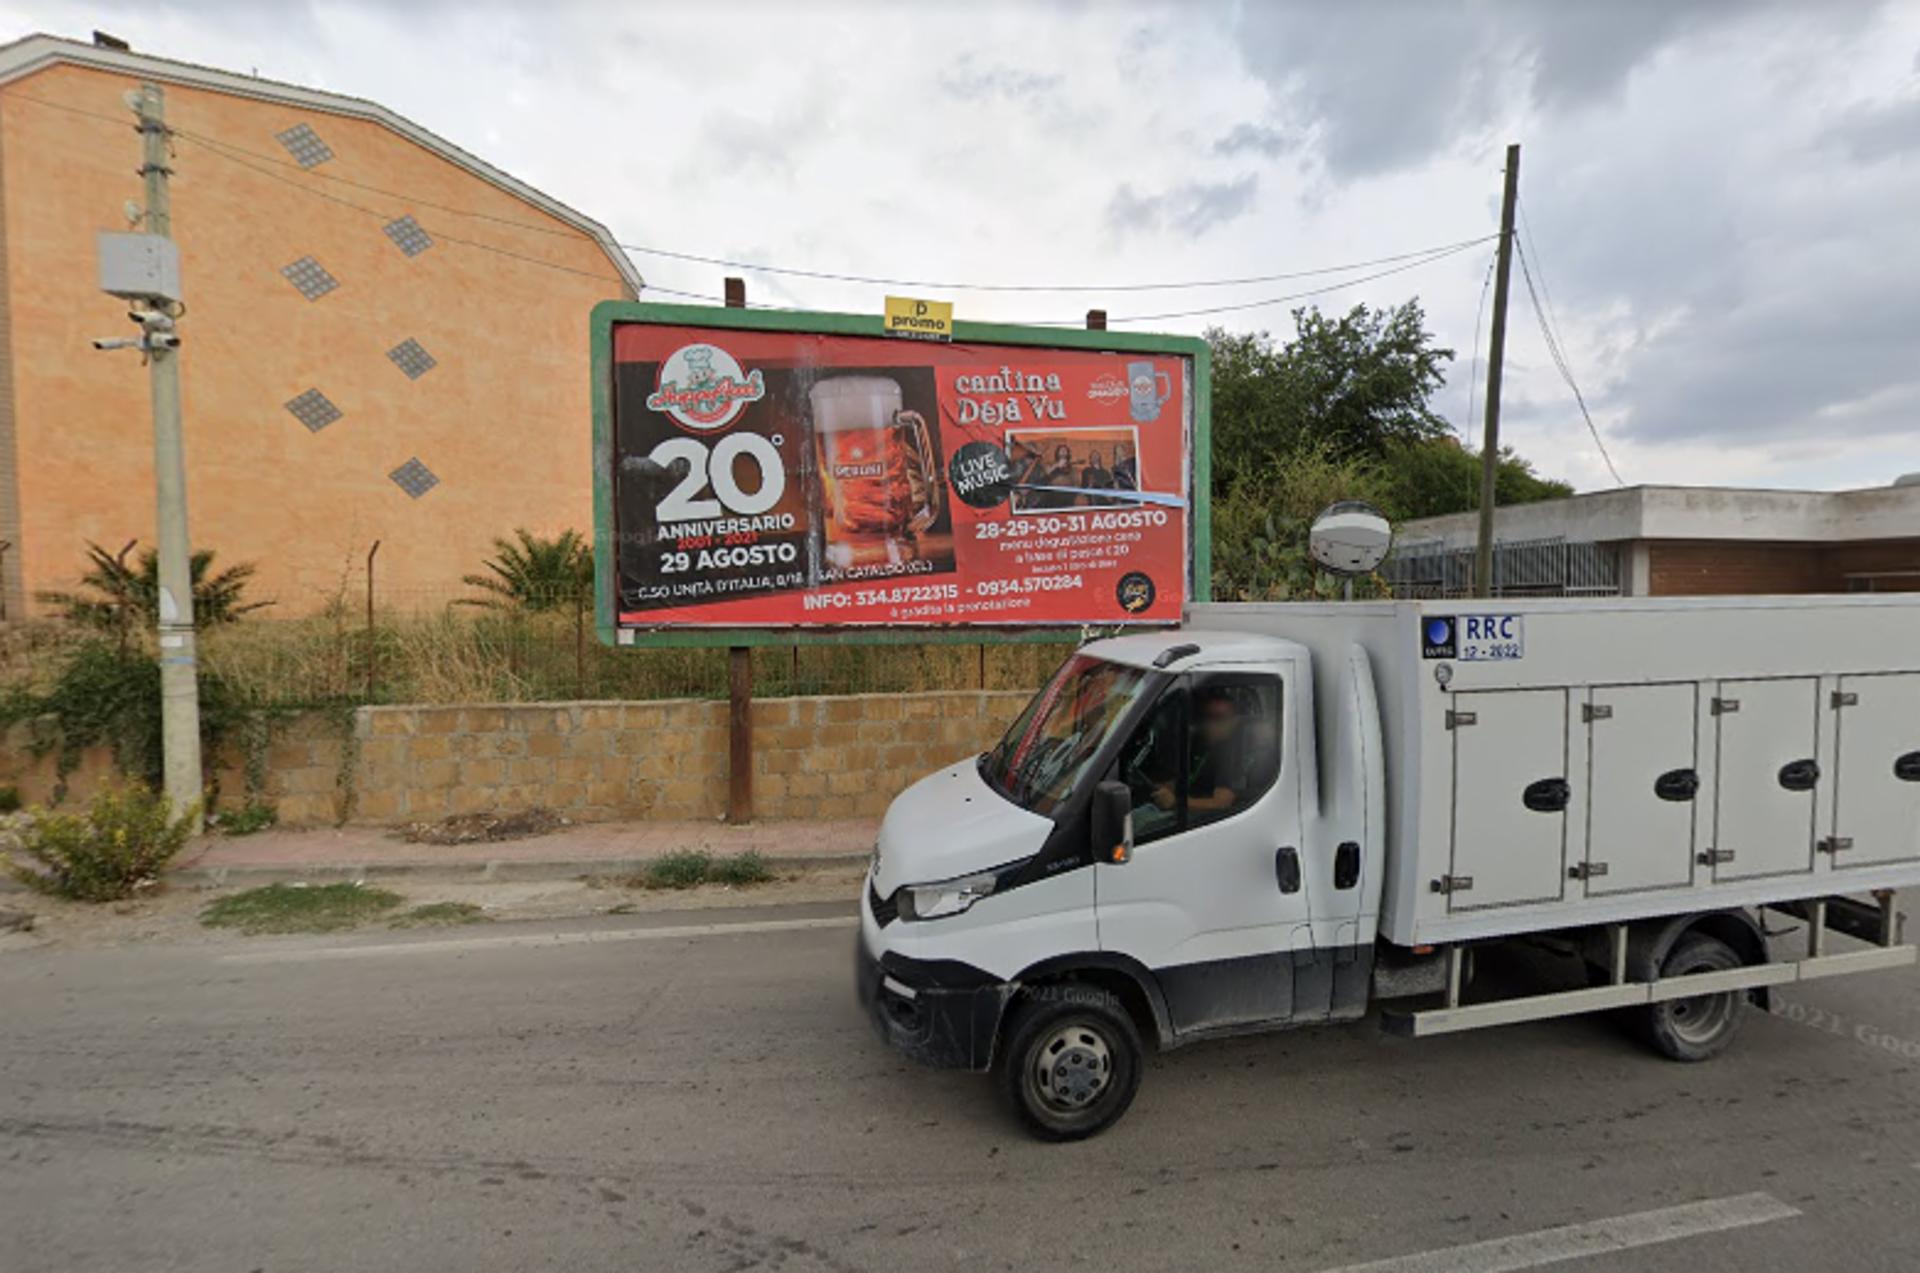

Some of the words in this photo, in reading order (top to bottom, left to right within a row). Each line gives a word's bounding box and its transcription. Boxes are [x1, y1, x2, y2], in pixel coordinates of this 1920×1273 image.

[892, 315, 945, 331] promo
[955, 366, 1063, 395] cantina
[1026, 395, 1067, 420] Vu
[959, 451, 998, 478] LIVE
[956, 464, 1011, 496] MUSIC
[656, 513, 796, 541] ANNIVERSARIO
[975, 513, 1086, 540] 28-29-30-31
[1090, 510, 1168, 531] AGOSTO
[660, 552, 690, 574] 29
[696, 542, 797, 571] AGOSTO
[846, 561, 905, 579] CATALDO
[803, 592, 852, 611] INFO:
[855, 584, 958, 606] 334.8722315
[976, 574, 1083, 596] 0934.570284
[1467, 615, 1513, 640] RRC
